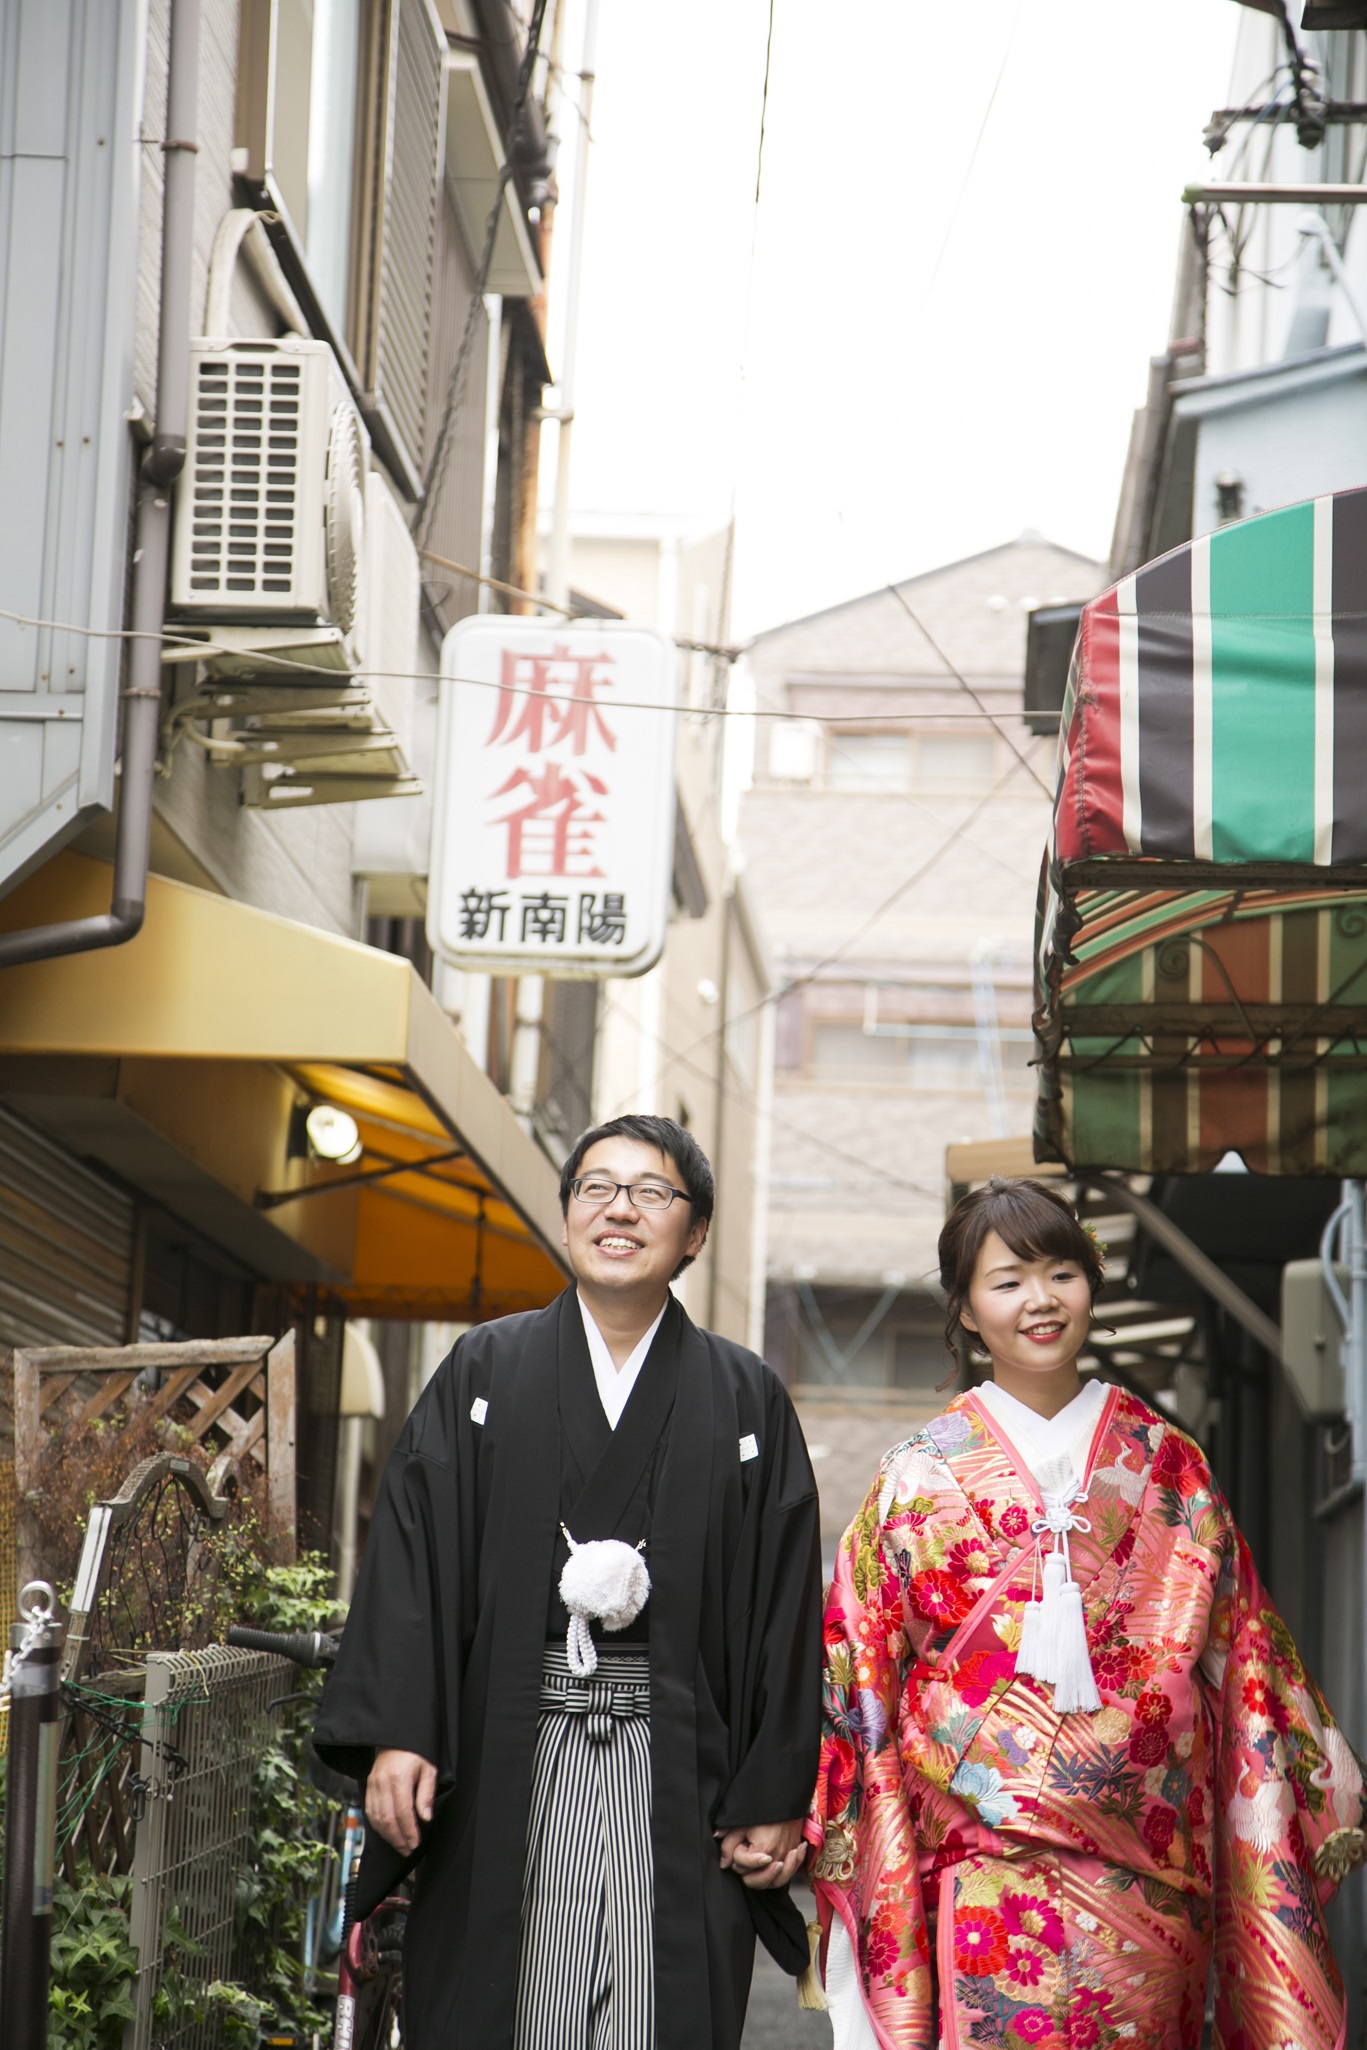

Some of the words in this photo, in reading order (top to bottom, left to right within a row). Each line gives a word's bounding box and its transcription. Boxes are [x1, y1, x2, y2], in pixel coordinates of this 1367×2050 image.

[484, 645, 617, 879] 麻雀
[459, 887, 627, 944] 新南陽
[335, 1995, 355, 2050] RHI
